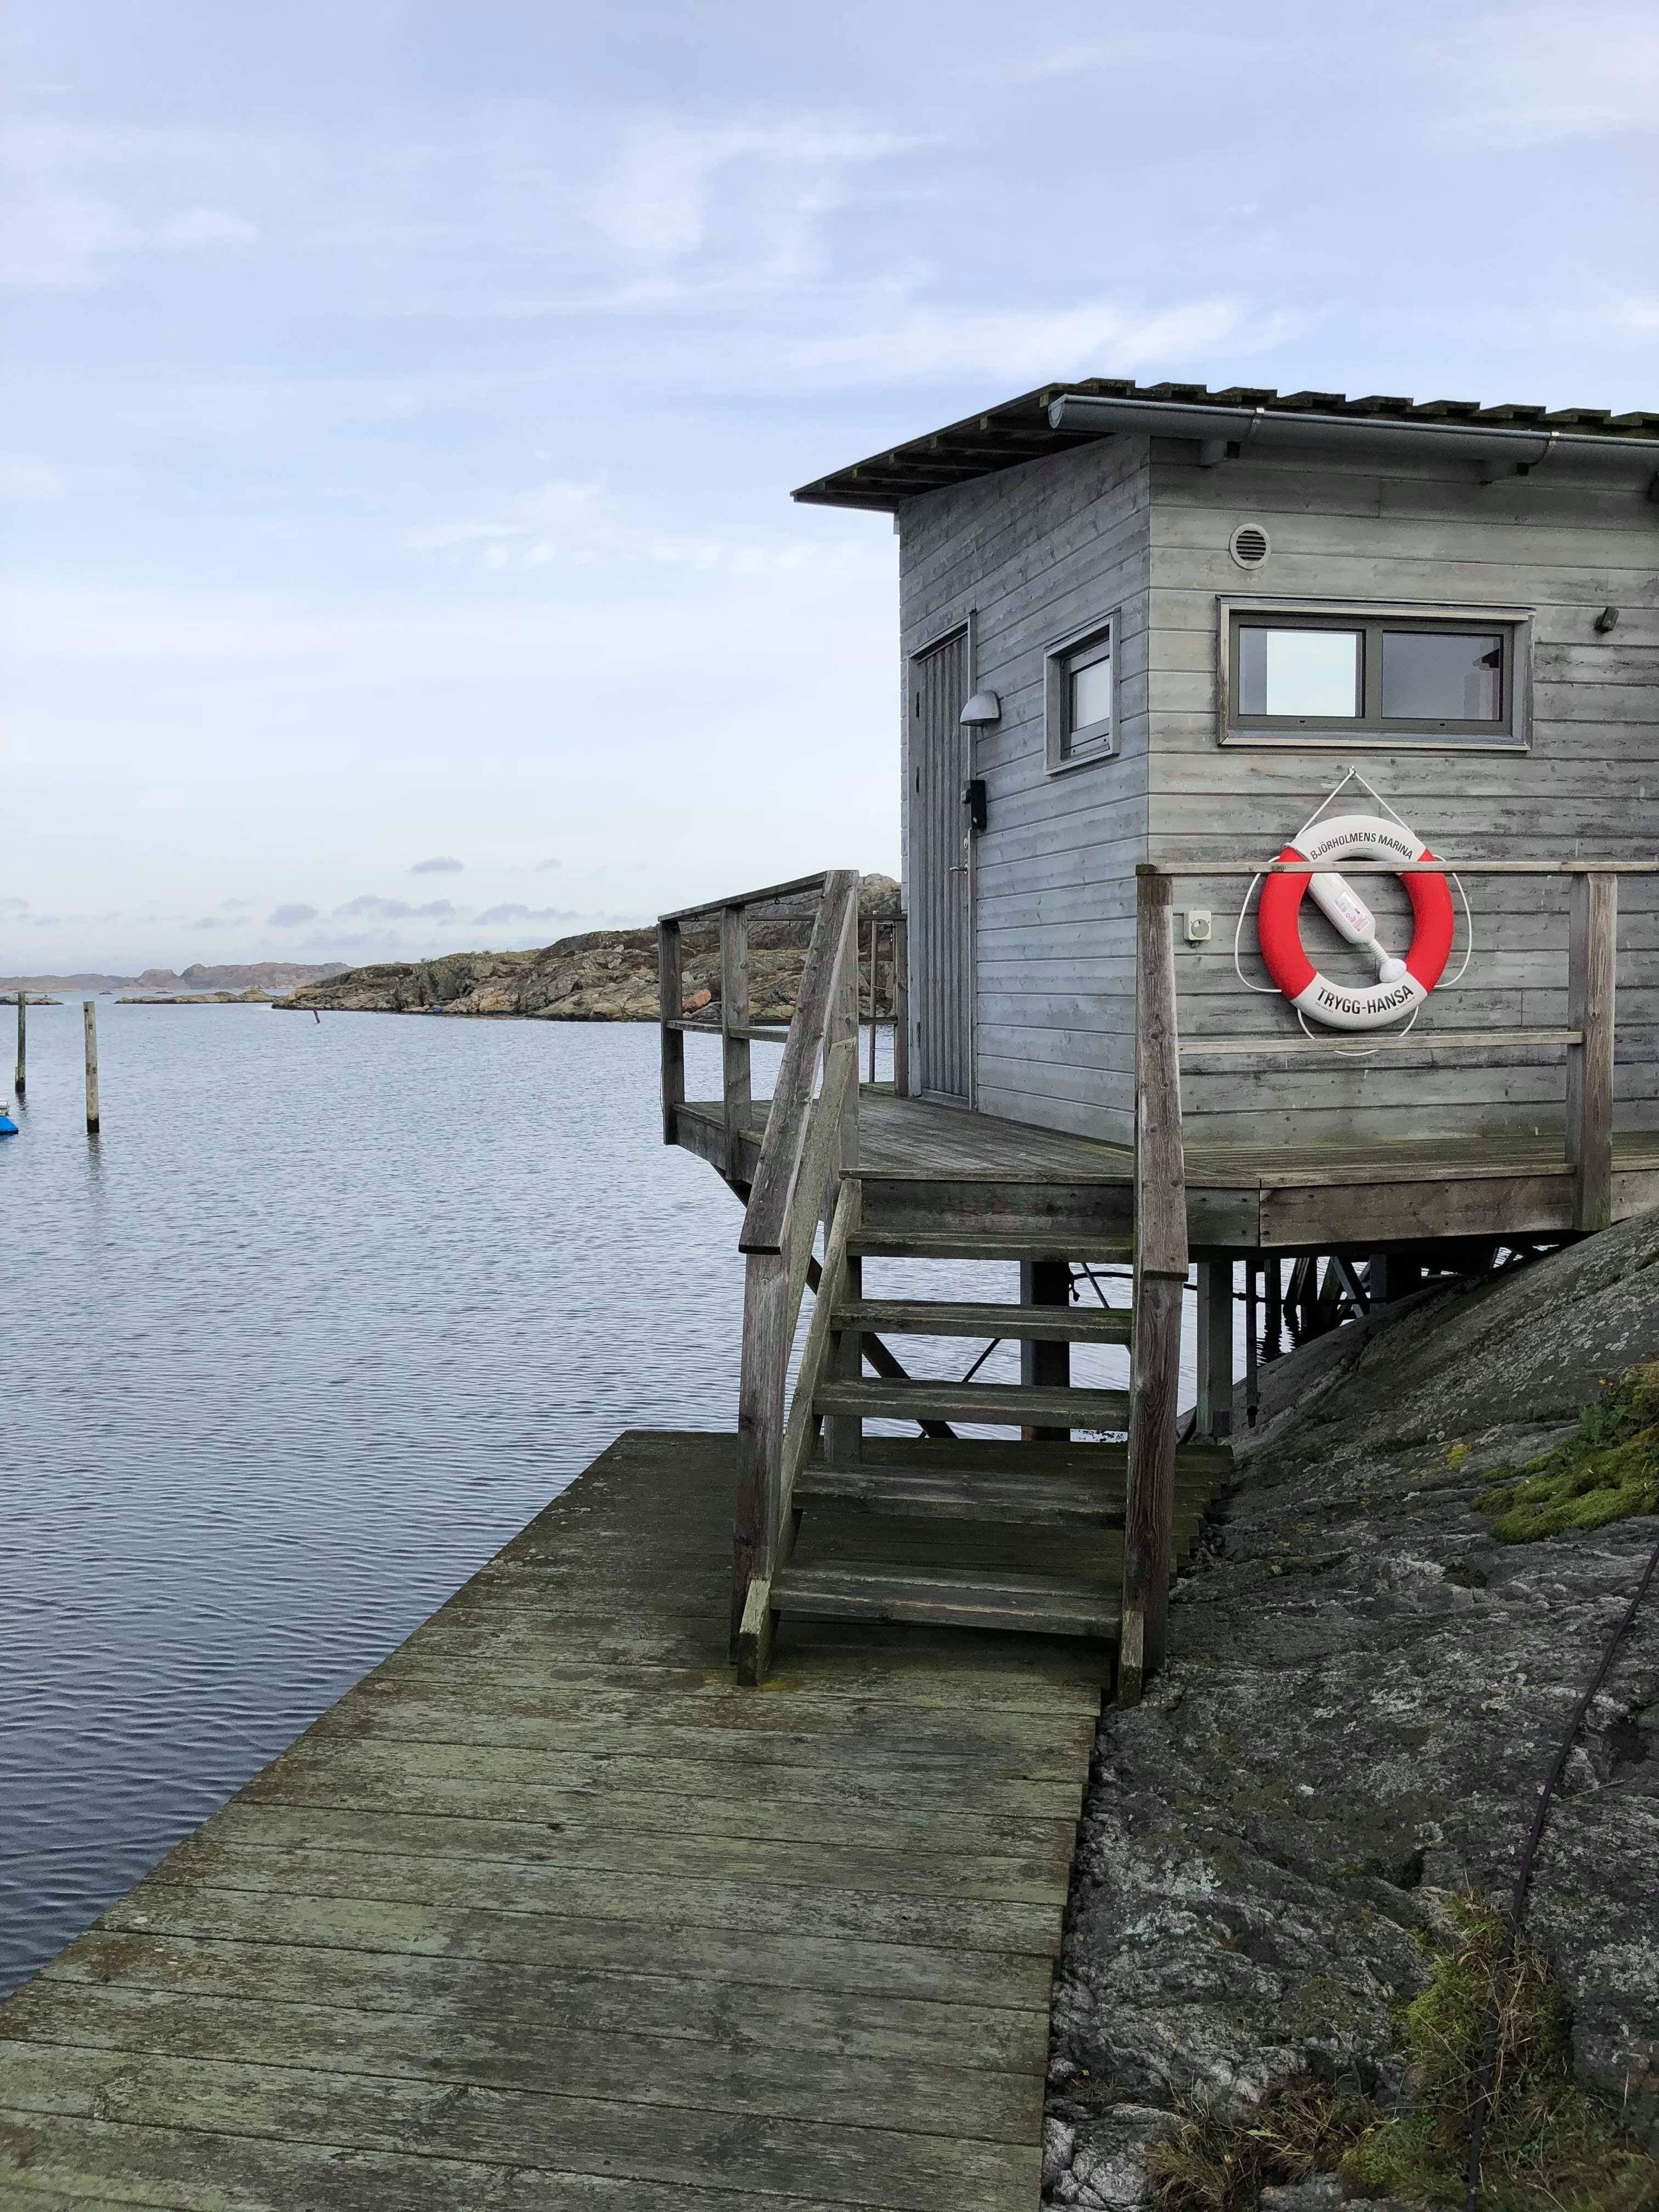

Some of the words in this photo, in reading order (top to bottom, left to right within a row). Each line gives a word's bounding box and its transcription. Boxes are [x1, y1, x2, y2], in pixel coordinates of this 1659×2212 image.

[1310, 832, 1376, 860] BJÖRHOLMENS
[1378, 835, 1413, 859] MARINA
[1317, 984, 1414, 1014] TRYGG-HANSA
